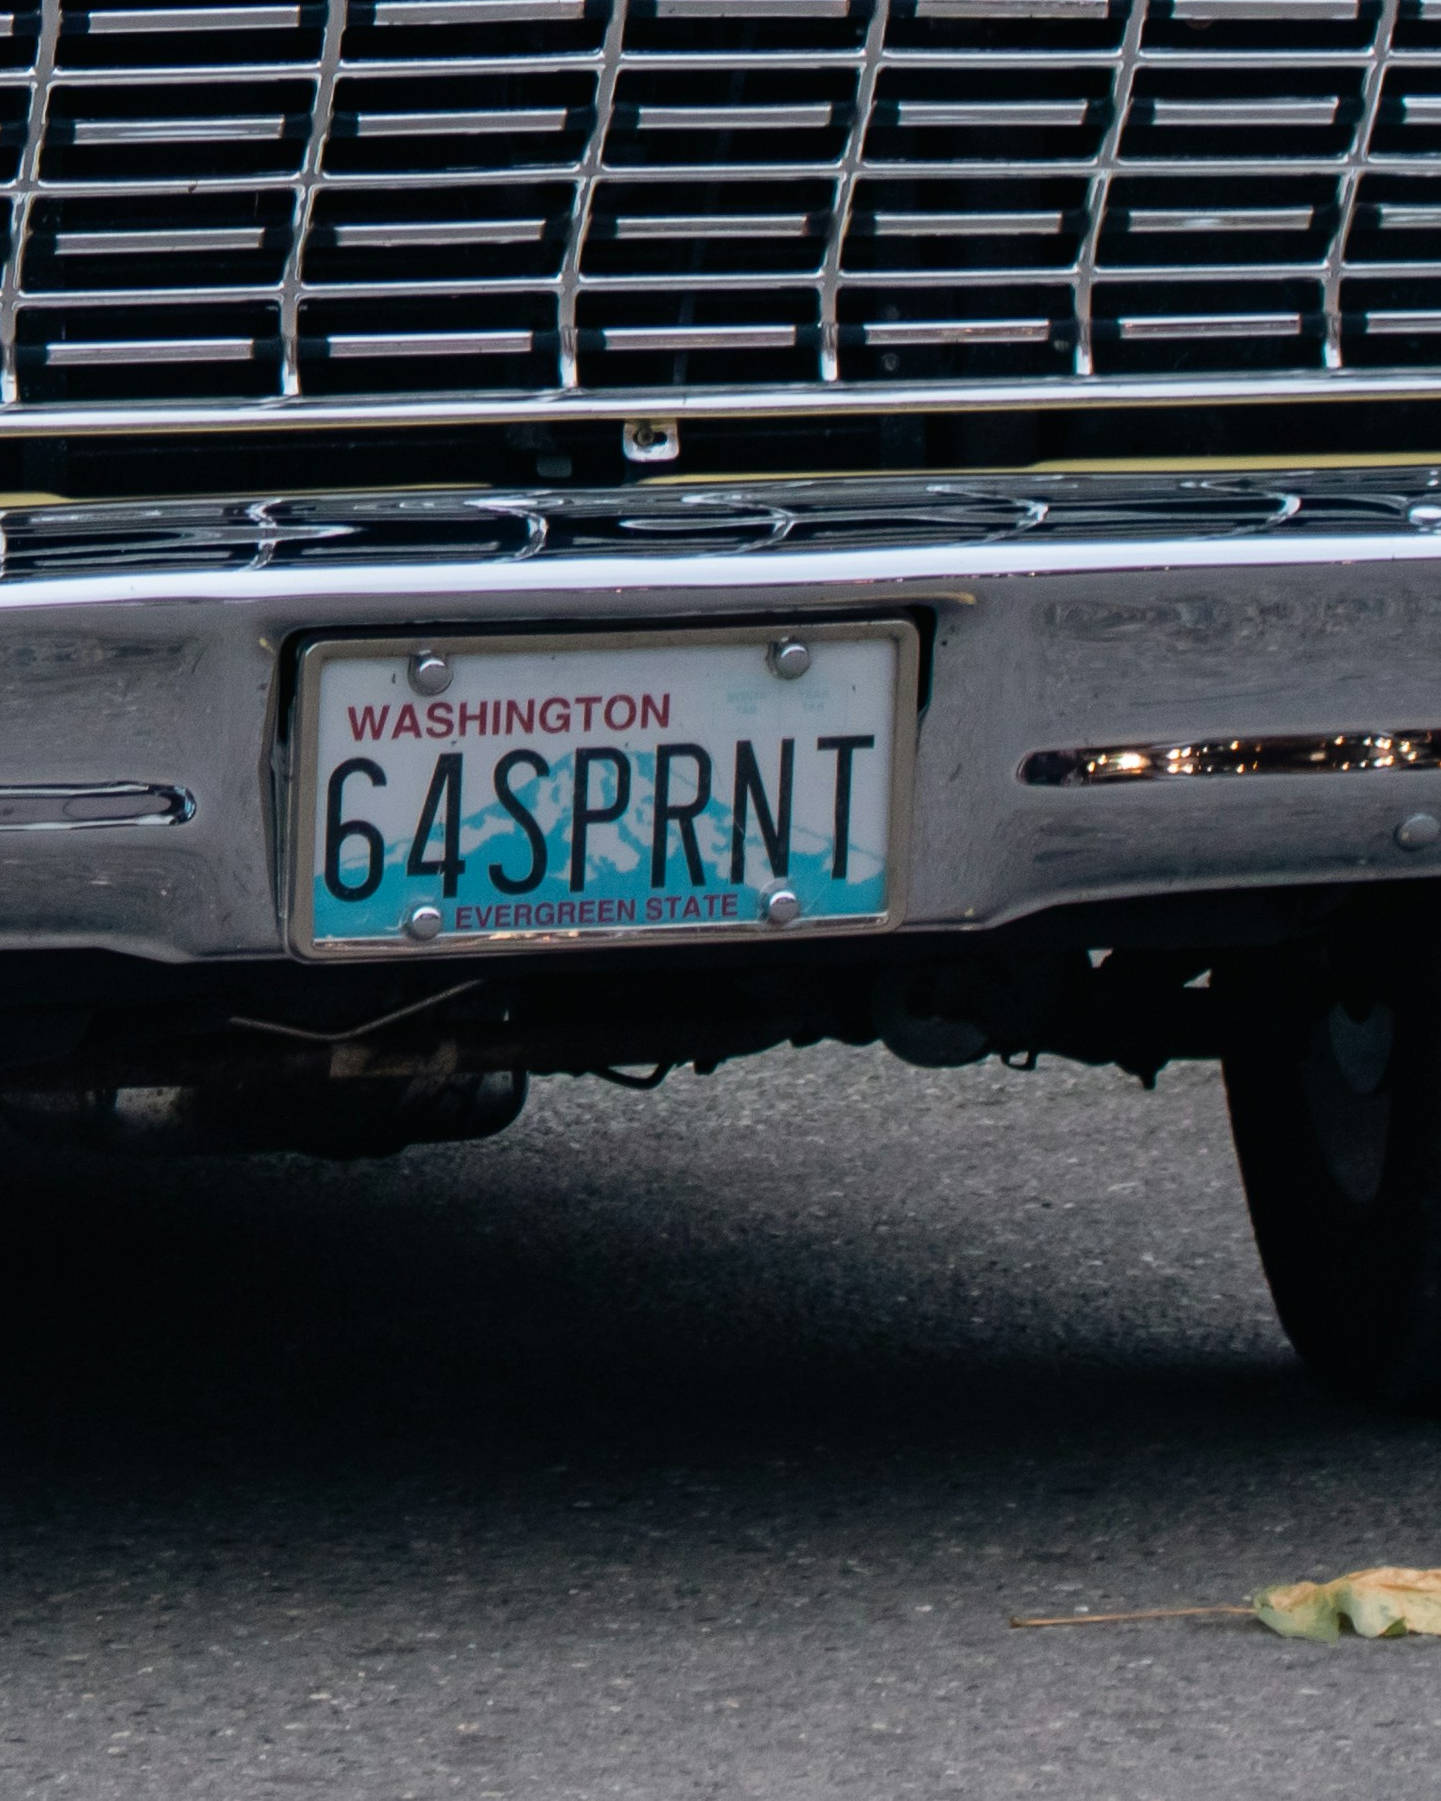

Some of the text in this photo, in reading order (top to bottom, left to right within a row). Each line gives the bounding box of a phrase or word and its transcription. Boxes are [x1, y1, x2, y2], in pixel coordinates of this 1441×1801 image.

[348, 693, 670, 741] WASHINGTON
[324, 735, 875, 903] 64SPRNT
[455, 893, 739, 930] EVERGREEN STATE
